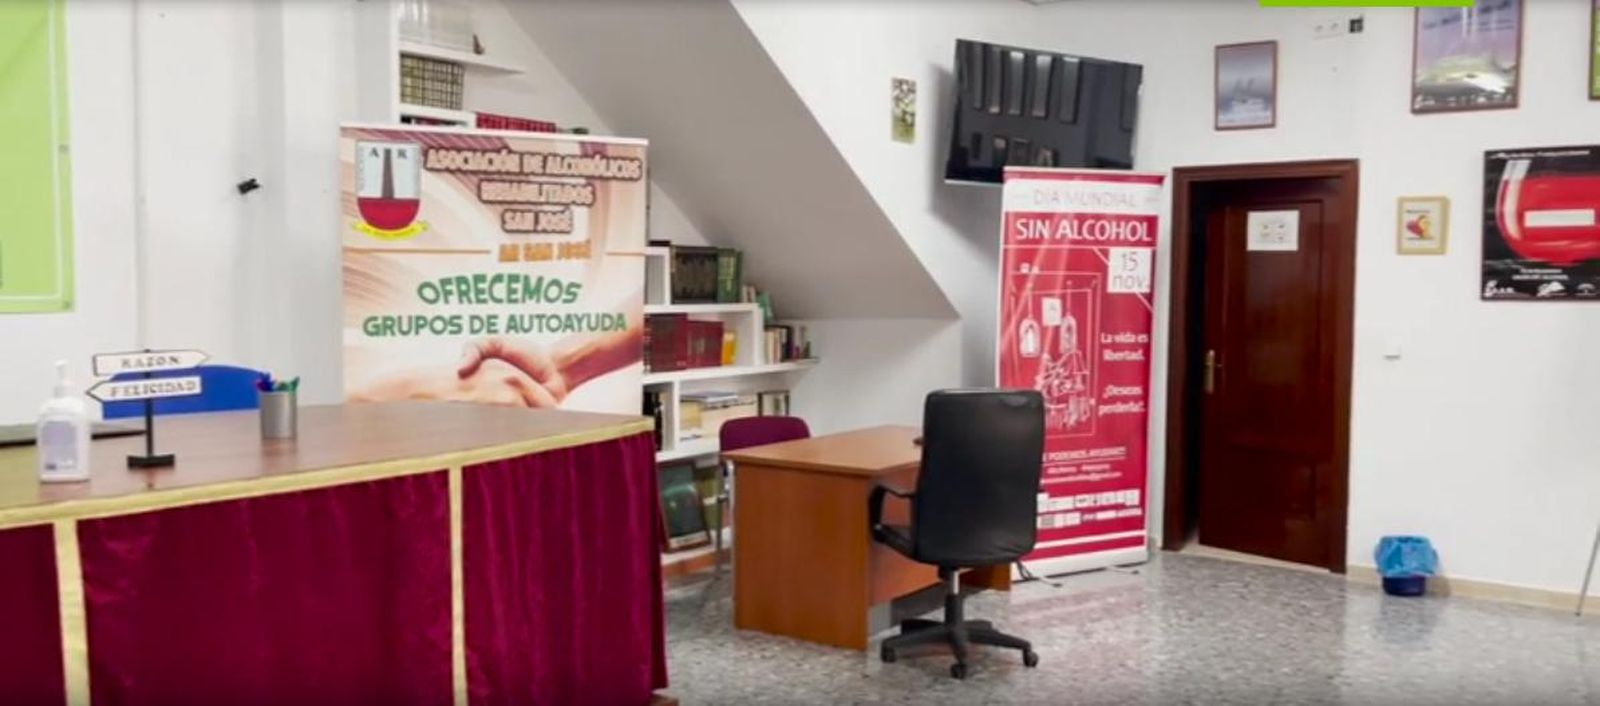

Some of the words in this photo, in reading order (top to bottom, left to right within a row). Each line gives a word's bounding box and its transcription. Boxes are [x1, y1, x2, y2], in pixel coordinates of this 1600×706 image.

[425, 148, 521, 173] ASOCIACIÓN
[522, 153, 544, 174] DE
[545, 153, 642, 179] ALCOHÓLICOS
[503, 209, 534, 231] SAN
[1015, 217, 1050, 240] SIN
[1055, 218, 1153, 242] ALCOHOL
[1121, 251, 1139, 273] 15
[416, 273, 583, 305] OFRECEMOS
[1113, 275, 1151, 290] nov.
[362, 314, 464, 337] GRUPOS
[468, 314, 499, 335] DE
[504, 312, 627, 334] AUTOAYUDA
[110, 380, 196, 397] FELICIDAD
